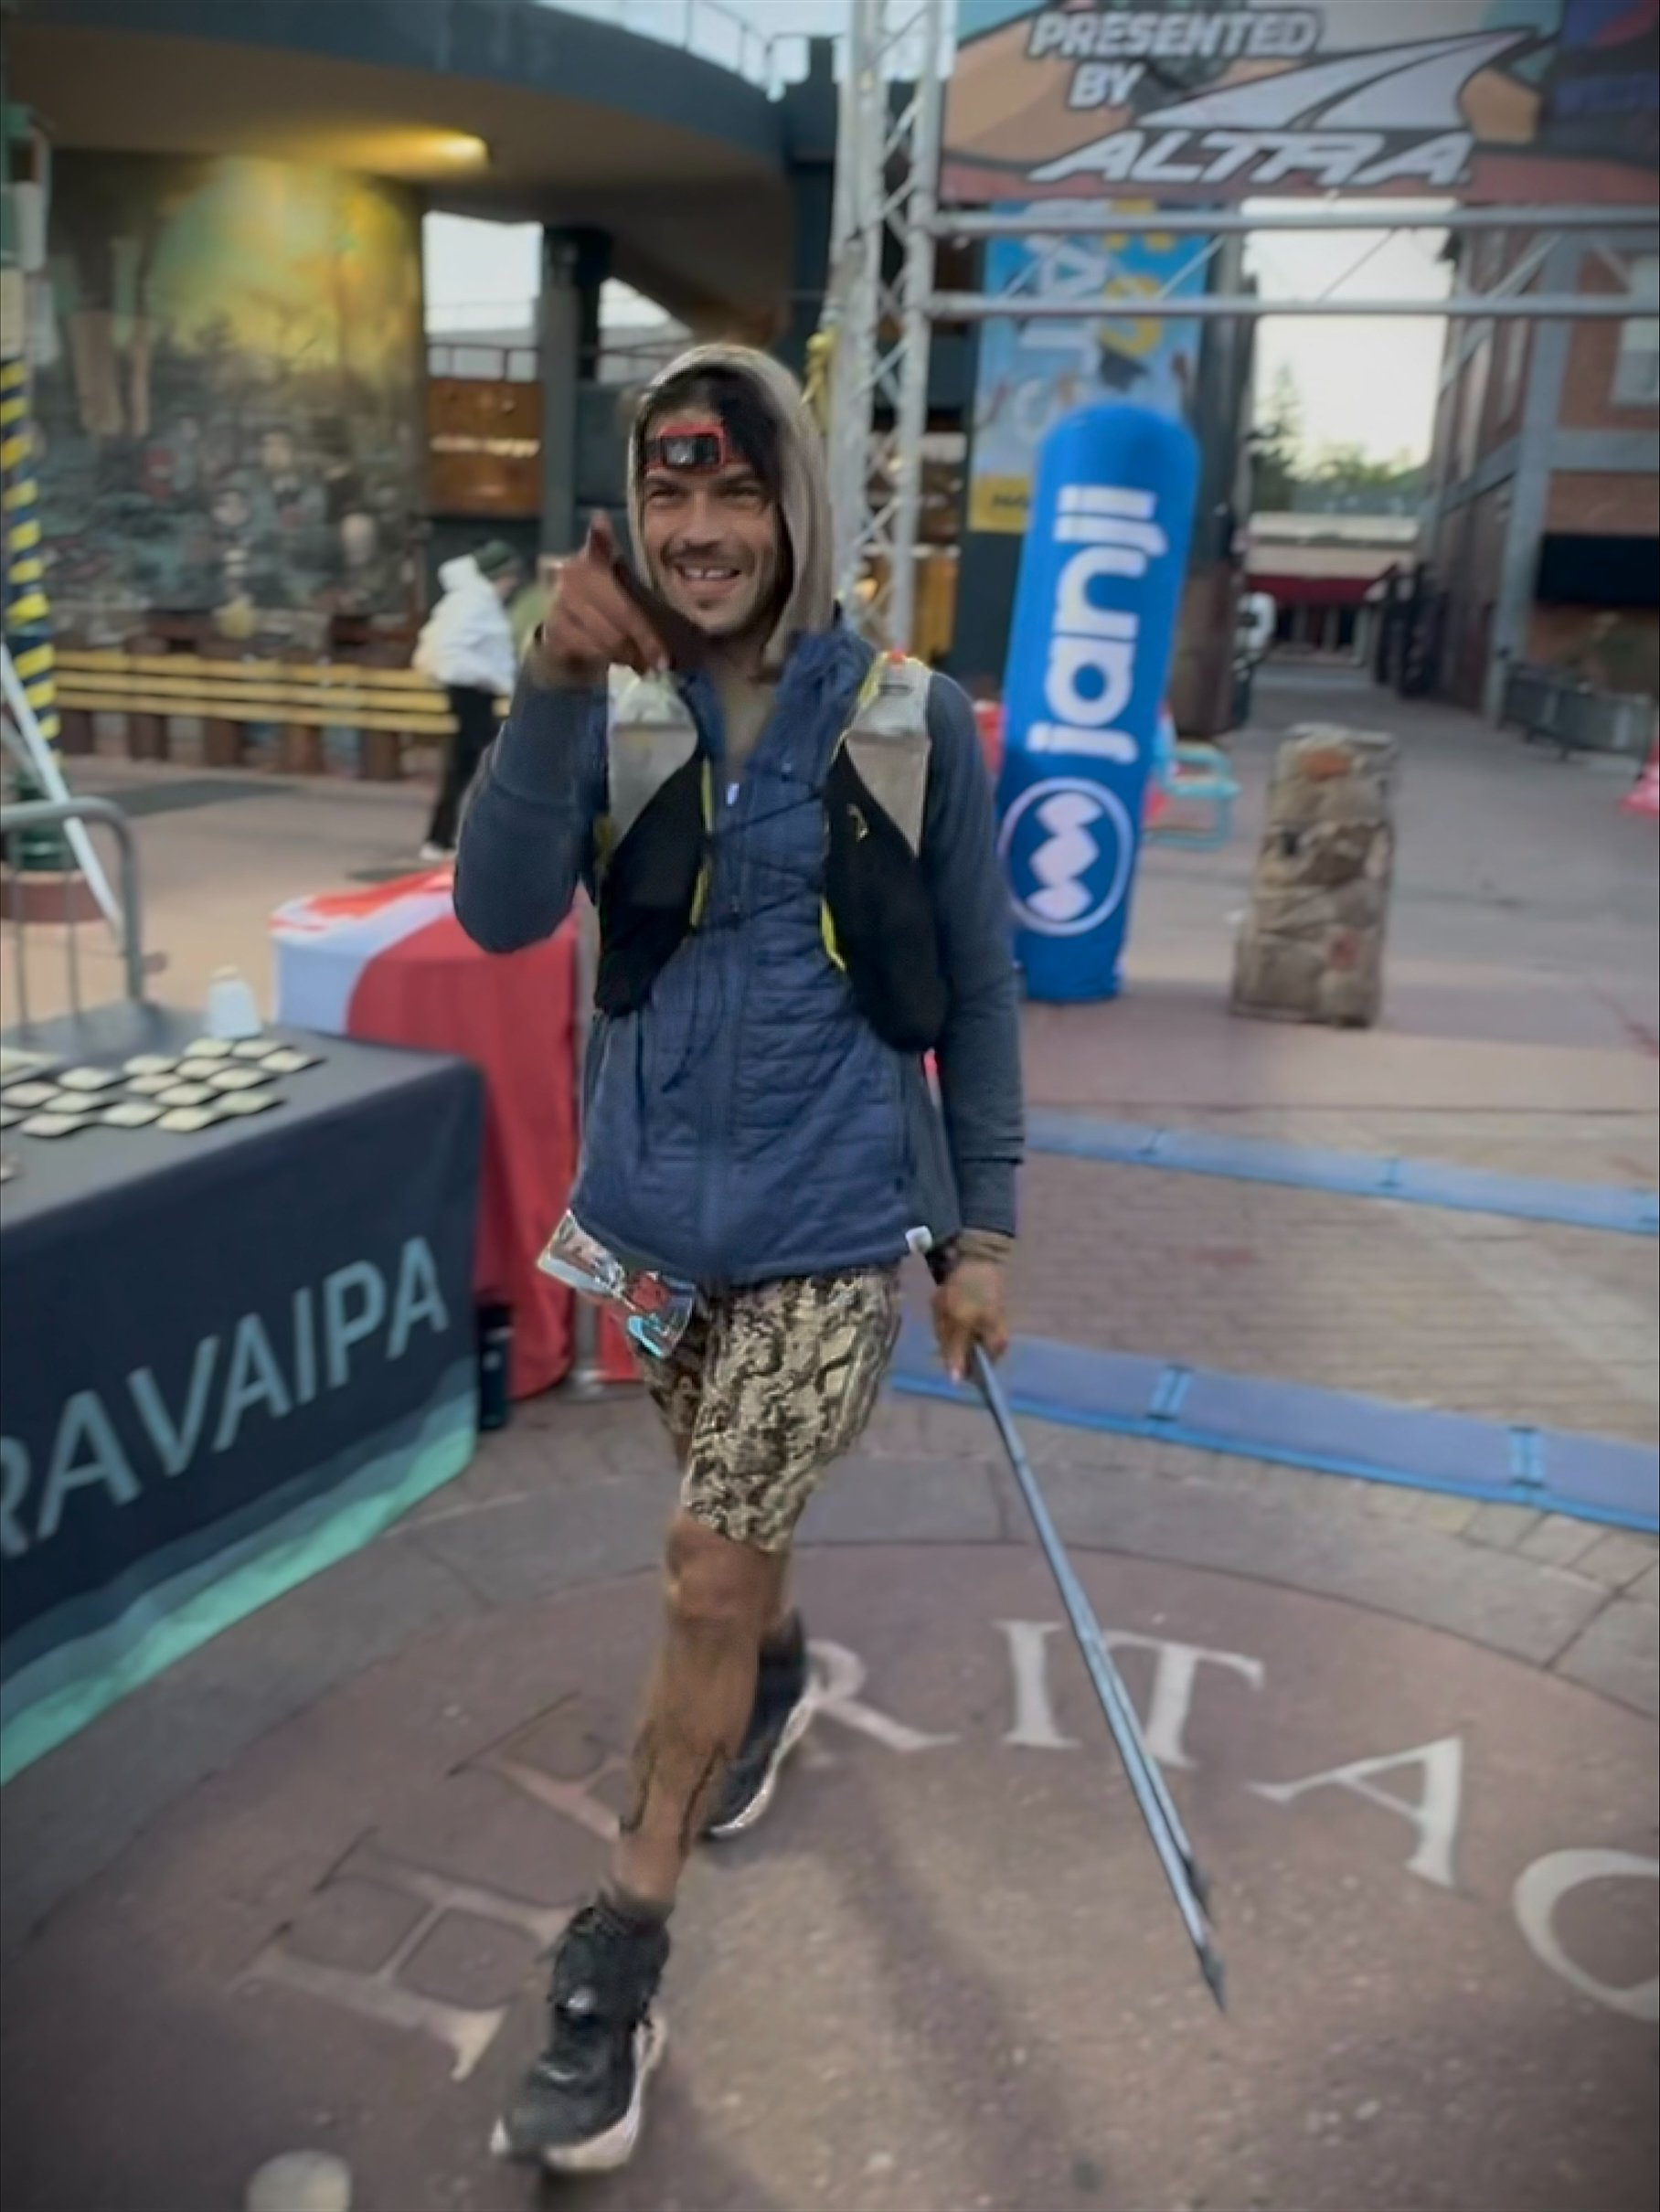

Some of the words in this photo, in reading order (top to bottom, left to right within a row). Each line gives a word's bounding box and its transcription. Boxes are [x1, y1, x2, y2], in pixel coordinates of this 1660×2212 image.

[1027, 11, 1319, 57] PRESENTED
[1069, 61, 1144, 109] BY
[1026, 130, 1474, 185] ALTRA
[1027, 484, 1168, 764] janji
